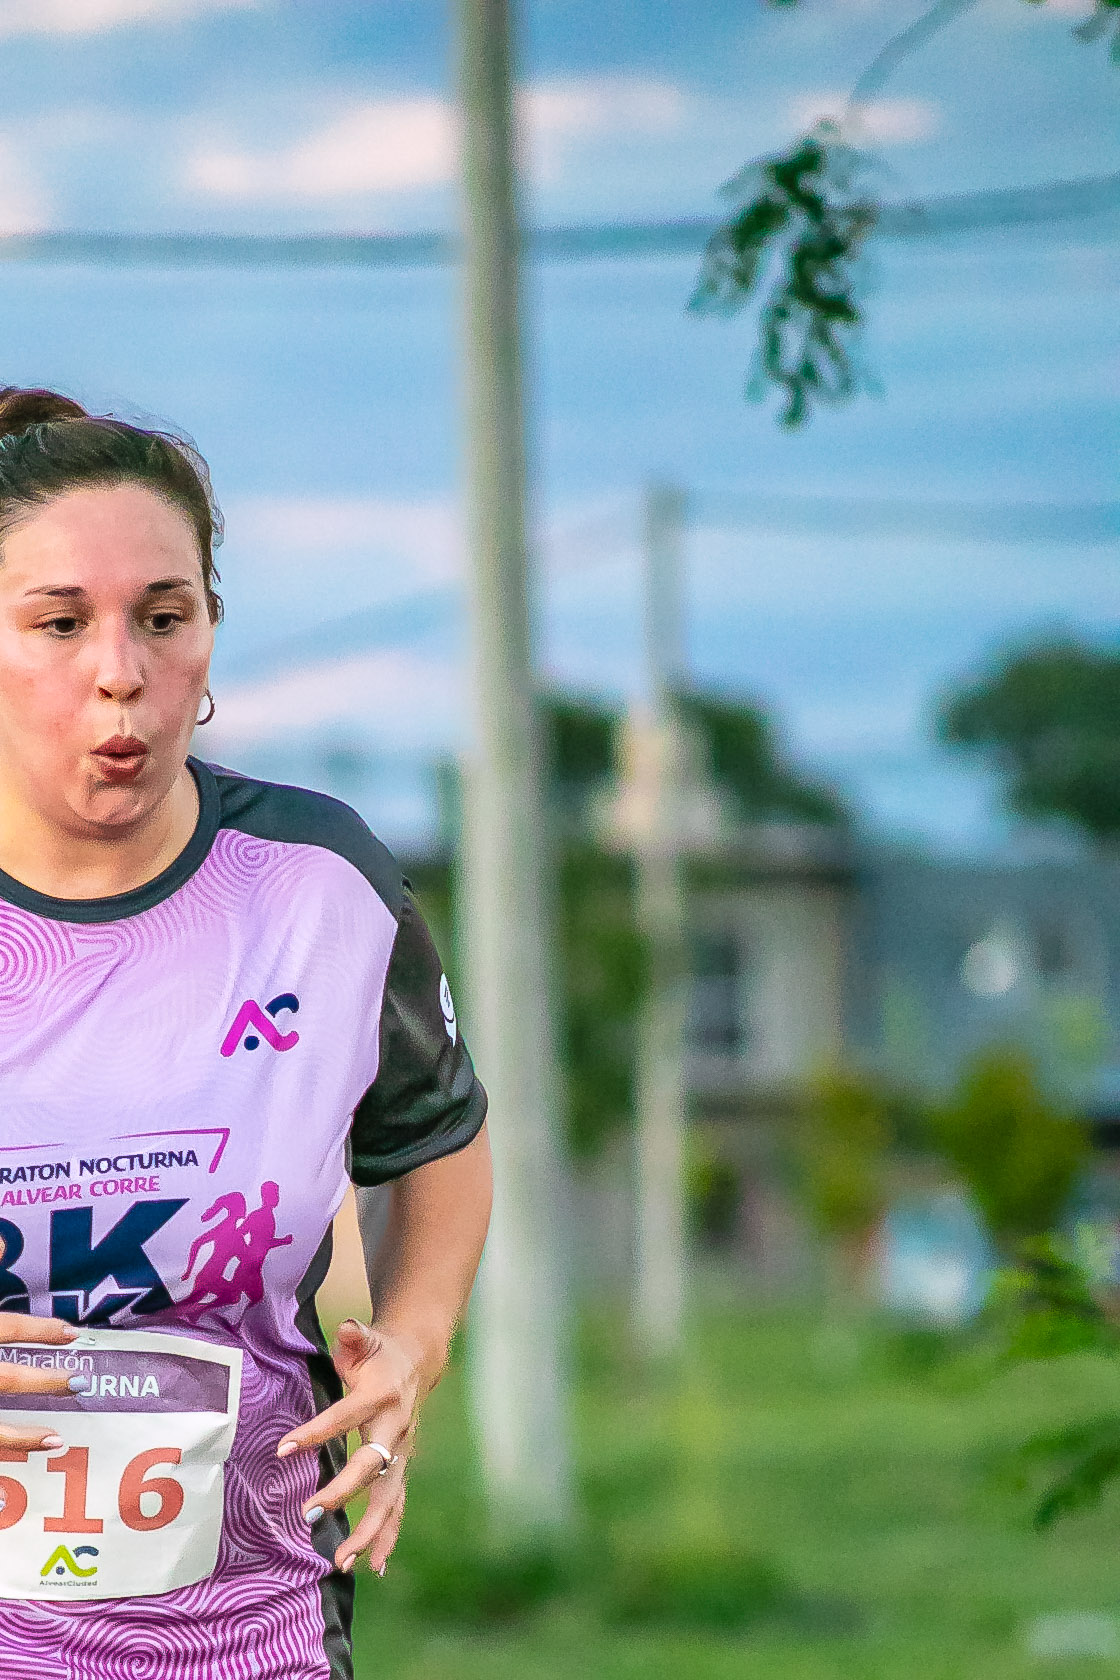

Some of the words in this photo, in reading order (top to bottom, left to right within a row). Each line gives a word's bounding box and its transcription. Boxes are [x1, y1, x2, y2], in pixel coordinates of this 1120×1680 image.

[79, 1149, 200, 1179] NOCTURNA
[0, 1183, 83, 1208] ALVEAR
[89, 1175, 161, 1198] CORRE
[80, 1374, 161, 1398] URNA
